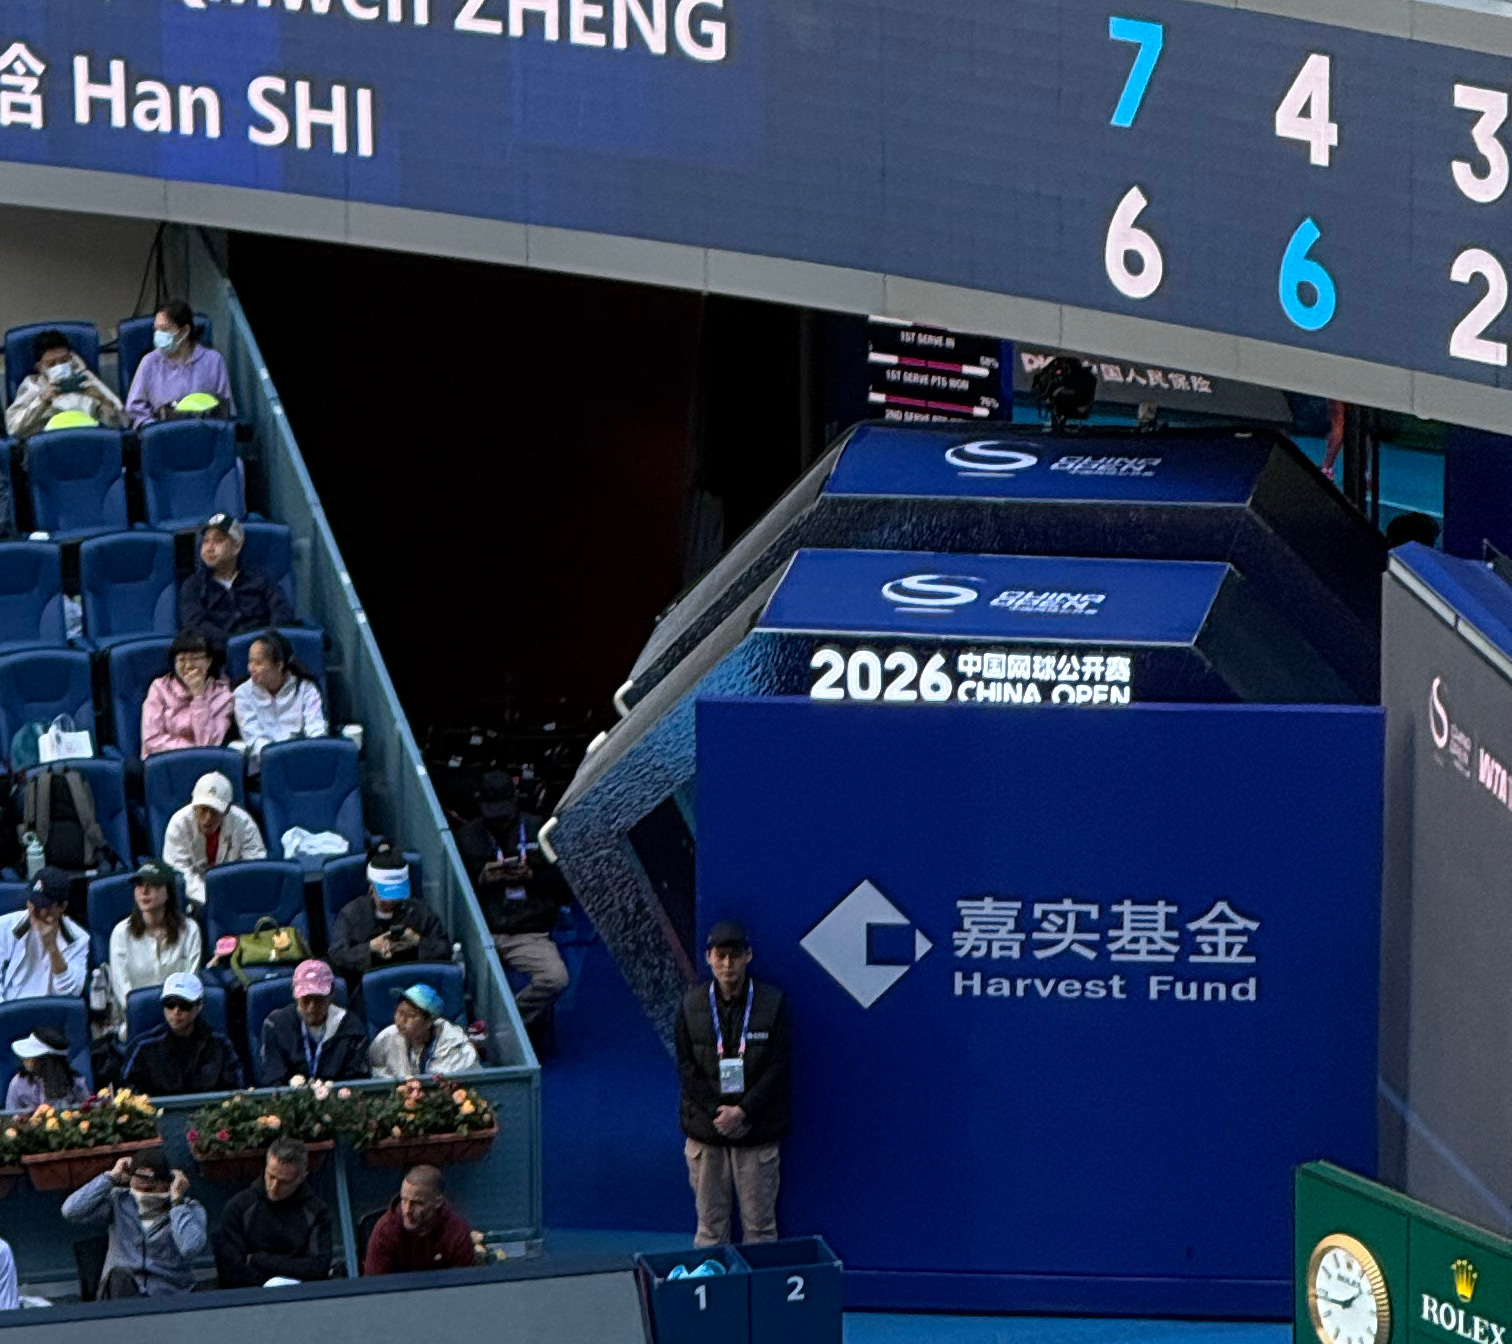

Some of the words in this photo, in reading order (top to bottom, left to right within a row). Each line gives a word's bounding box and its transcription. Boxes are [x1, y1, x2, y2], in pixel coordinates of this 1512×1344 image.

[1108, 16, 1164, 128] 7
[1275, 53, 1338, 167] 4
[1451, 84, 1510, 203] 3
[73, 55, 221, 139] Han
[247, 75, 374, 157] SHI
[1104, 185, 1163, 299] 6
[1278, 217, 1337, 331] 6
[1449, 248, 1508, 367] 2
[810, 648, 953, 702] 2026
[957, 651, 1131, 683] 中国网球公开赛
[957, 680, 1042, 704] CHINA
[1051, 683, 1131, 705] OPEN
[952, 896, 1261, 963] 嘉实基金
[953, 971, 1127, 999] Harvest
[1149, 975, 1257, 1001] Fund
[694, 1284, 707, 1310] 1
[787, 1275, 805, 1302] 2
